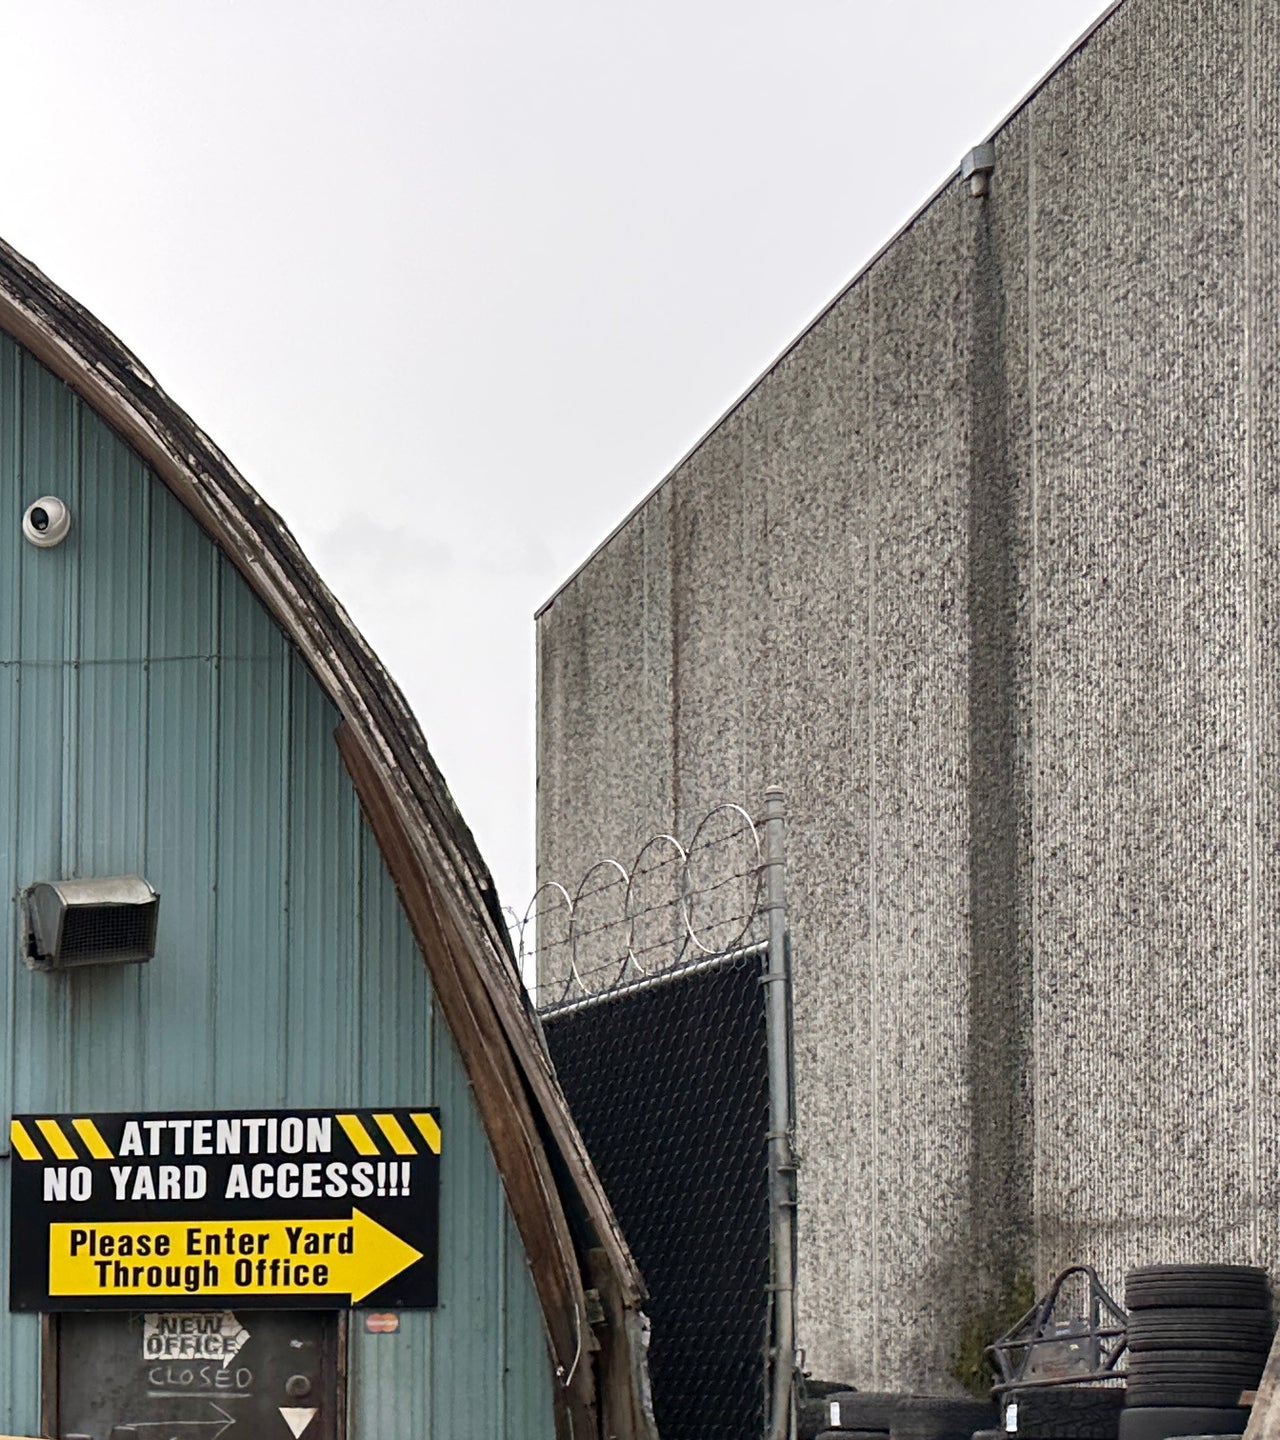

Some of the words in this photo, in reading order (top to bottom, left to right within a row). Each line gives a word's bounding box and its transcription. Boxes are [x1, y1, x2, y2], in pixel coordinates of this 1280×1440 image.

[119, 1117, 332, 1156] ATTENTION
[43, 1165, 92, 1202] NO
[110, 1163, 207, 1201] YARD
[225, 1161, 411, 1198] ACCESS!!!
[69, 1228, 171, 1257] Please
[186, 1227, 270, 1256] Enter
[284, 1226, 355, 1254] Yard
[94, 1259, 219, 1292] Through
[234, 1257, 329, 1287] Office
[159, 1317, 222, 1335] NEW
[146, 1334, 236, 1356] OFFICE
[148, 1366, 253, 1388] CLOSED
